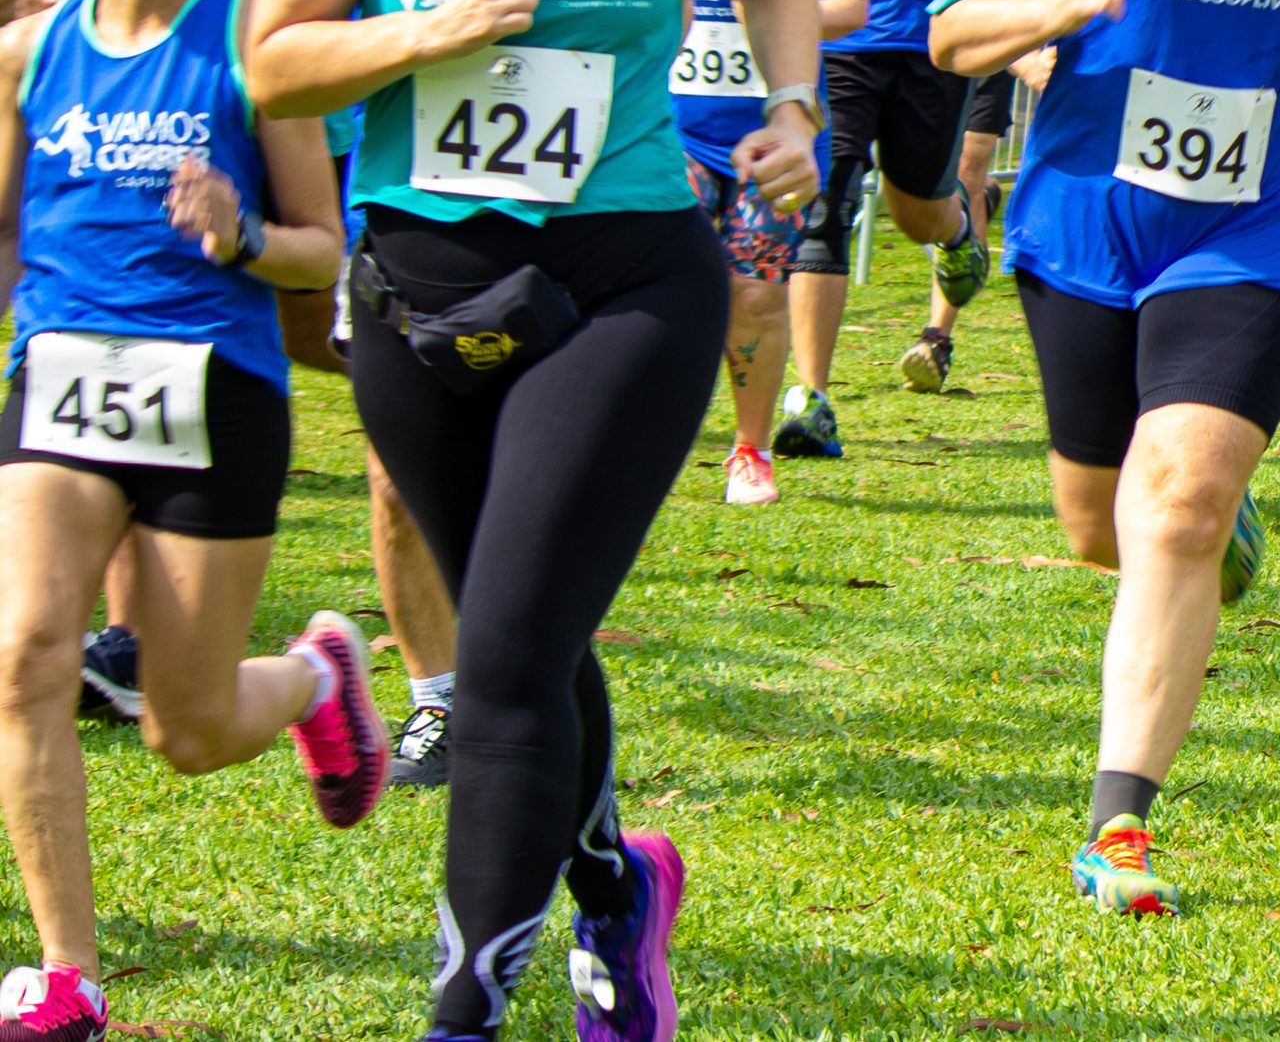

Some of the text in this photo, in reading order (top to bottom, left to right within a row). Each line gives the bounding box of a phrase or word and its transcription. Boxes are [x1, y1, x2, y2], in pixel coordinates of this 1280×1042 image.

[677, 49, 751, 85] 393
[97, 110, 211, 145] VAMOS
[434, 98, 584, 179] 424
[1137, 116, 1248, 185] 394
[52, 376, 174, 446] 451
